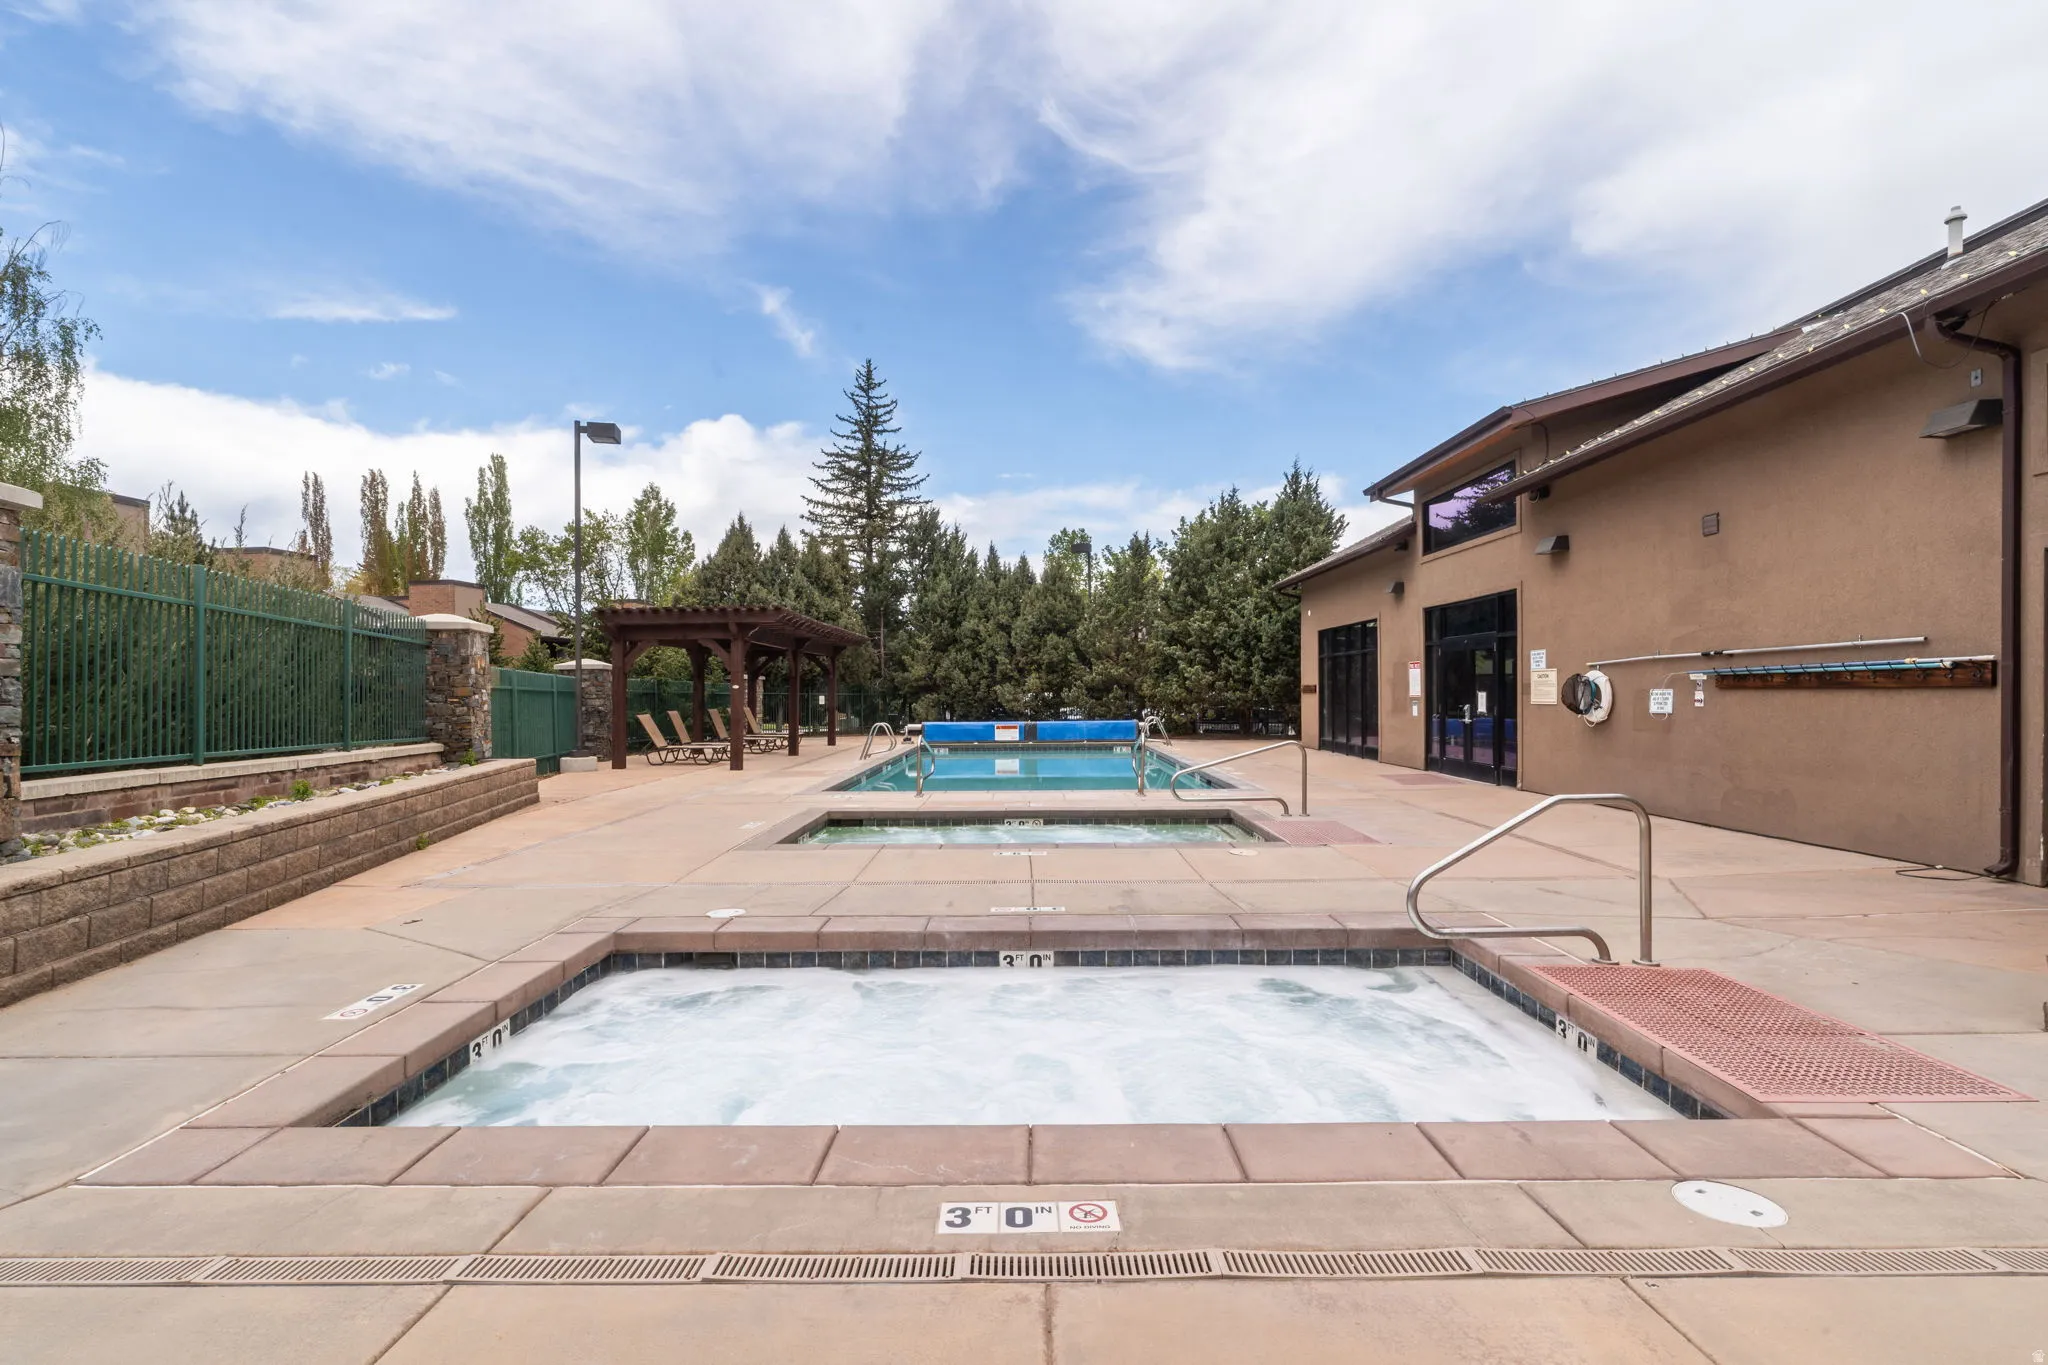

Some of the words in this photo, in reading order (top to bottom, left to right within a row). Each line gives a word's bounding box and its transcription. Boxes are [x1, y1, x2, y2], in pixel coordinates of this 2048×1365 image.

[1043, 953, 1051, 961] IN
[481, 1035, 489, 1047] FT
[501, 1022, 509, 1034] IN
[1557, 1018, 1567, 1039] 3
[944, 1206, 972, 1228] 3
[974, 1206, 993, 1214] FT
[1005, 1206, 1033, 1228] 0
[1035, 1206, 1052, 1214] IN
